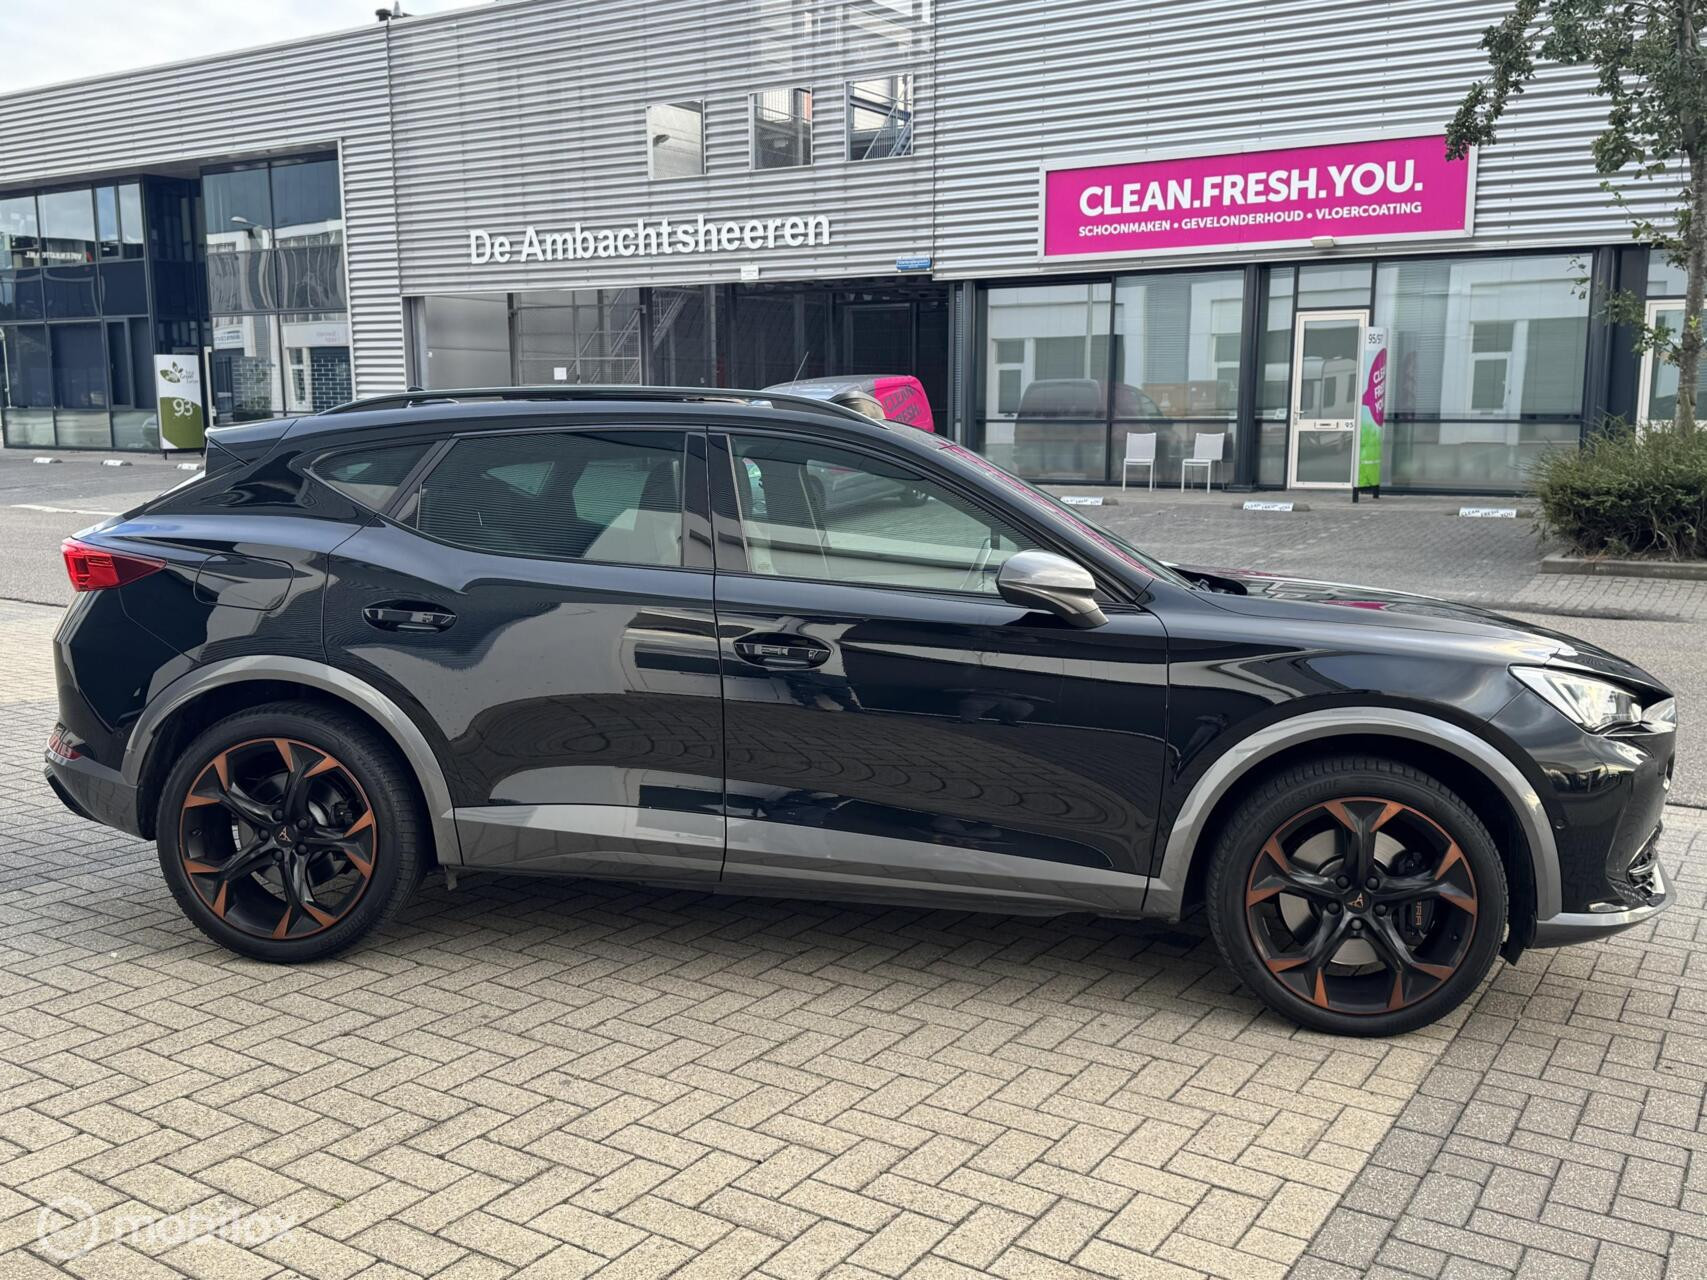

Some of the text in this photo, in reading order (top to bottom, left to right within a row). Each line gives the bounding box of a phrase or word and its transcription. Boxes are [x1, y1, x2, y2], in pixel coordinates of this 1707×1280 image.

[1079, 159, 1424, 217] CLEAN.FRESH.YOU.
[470, 214, 831, 264] De Ambachtsheeren
[1079, 202, 1422, 237] SCHOONMAKEN GEVELONDERHOUD VLOERCOATING
[173, 399, 193, 417] 93
